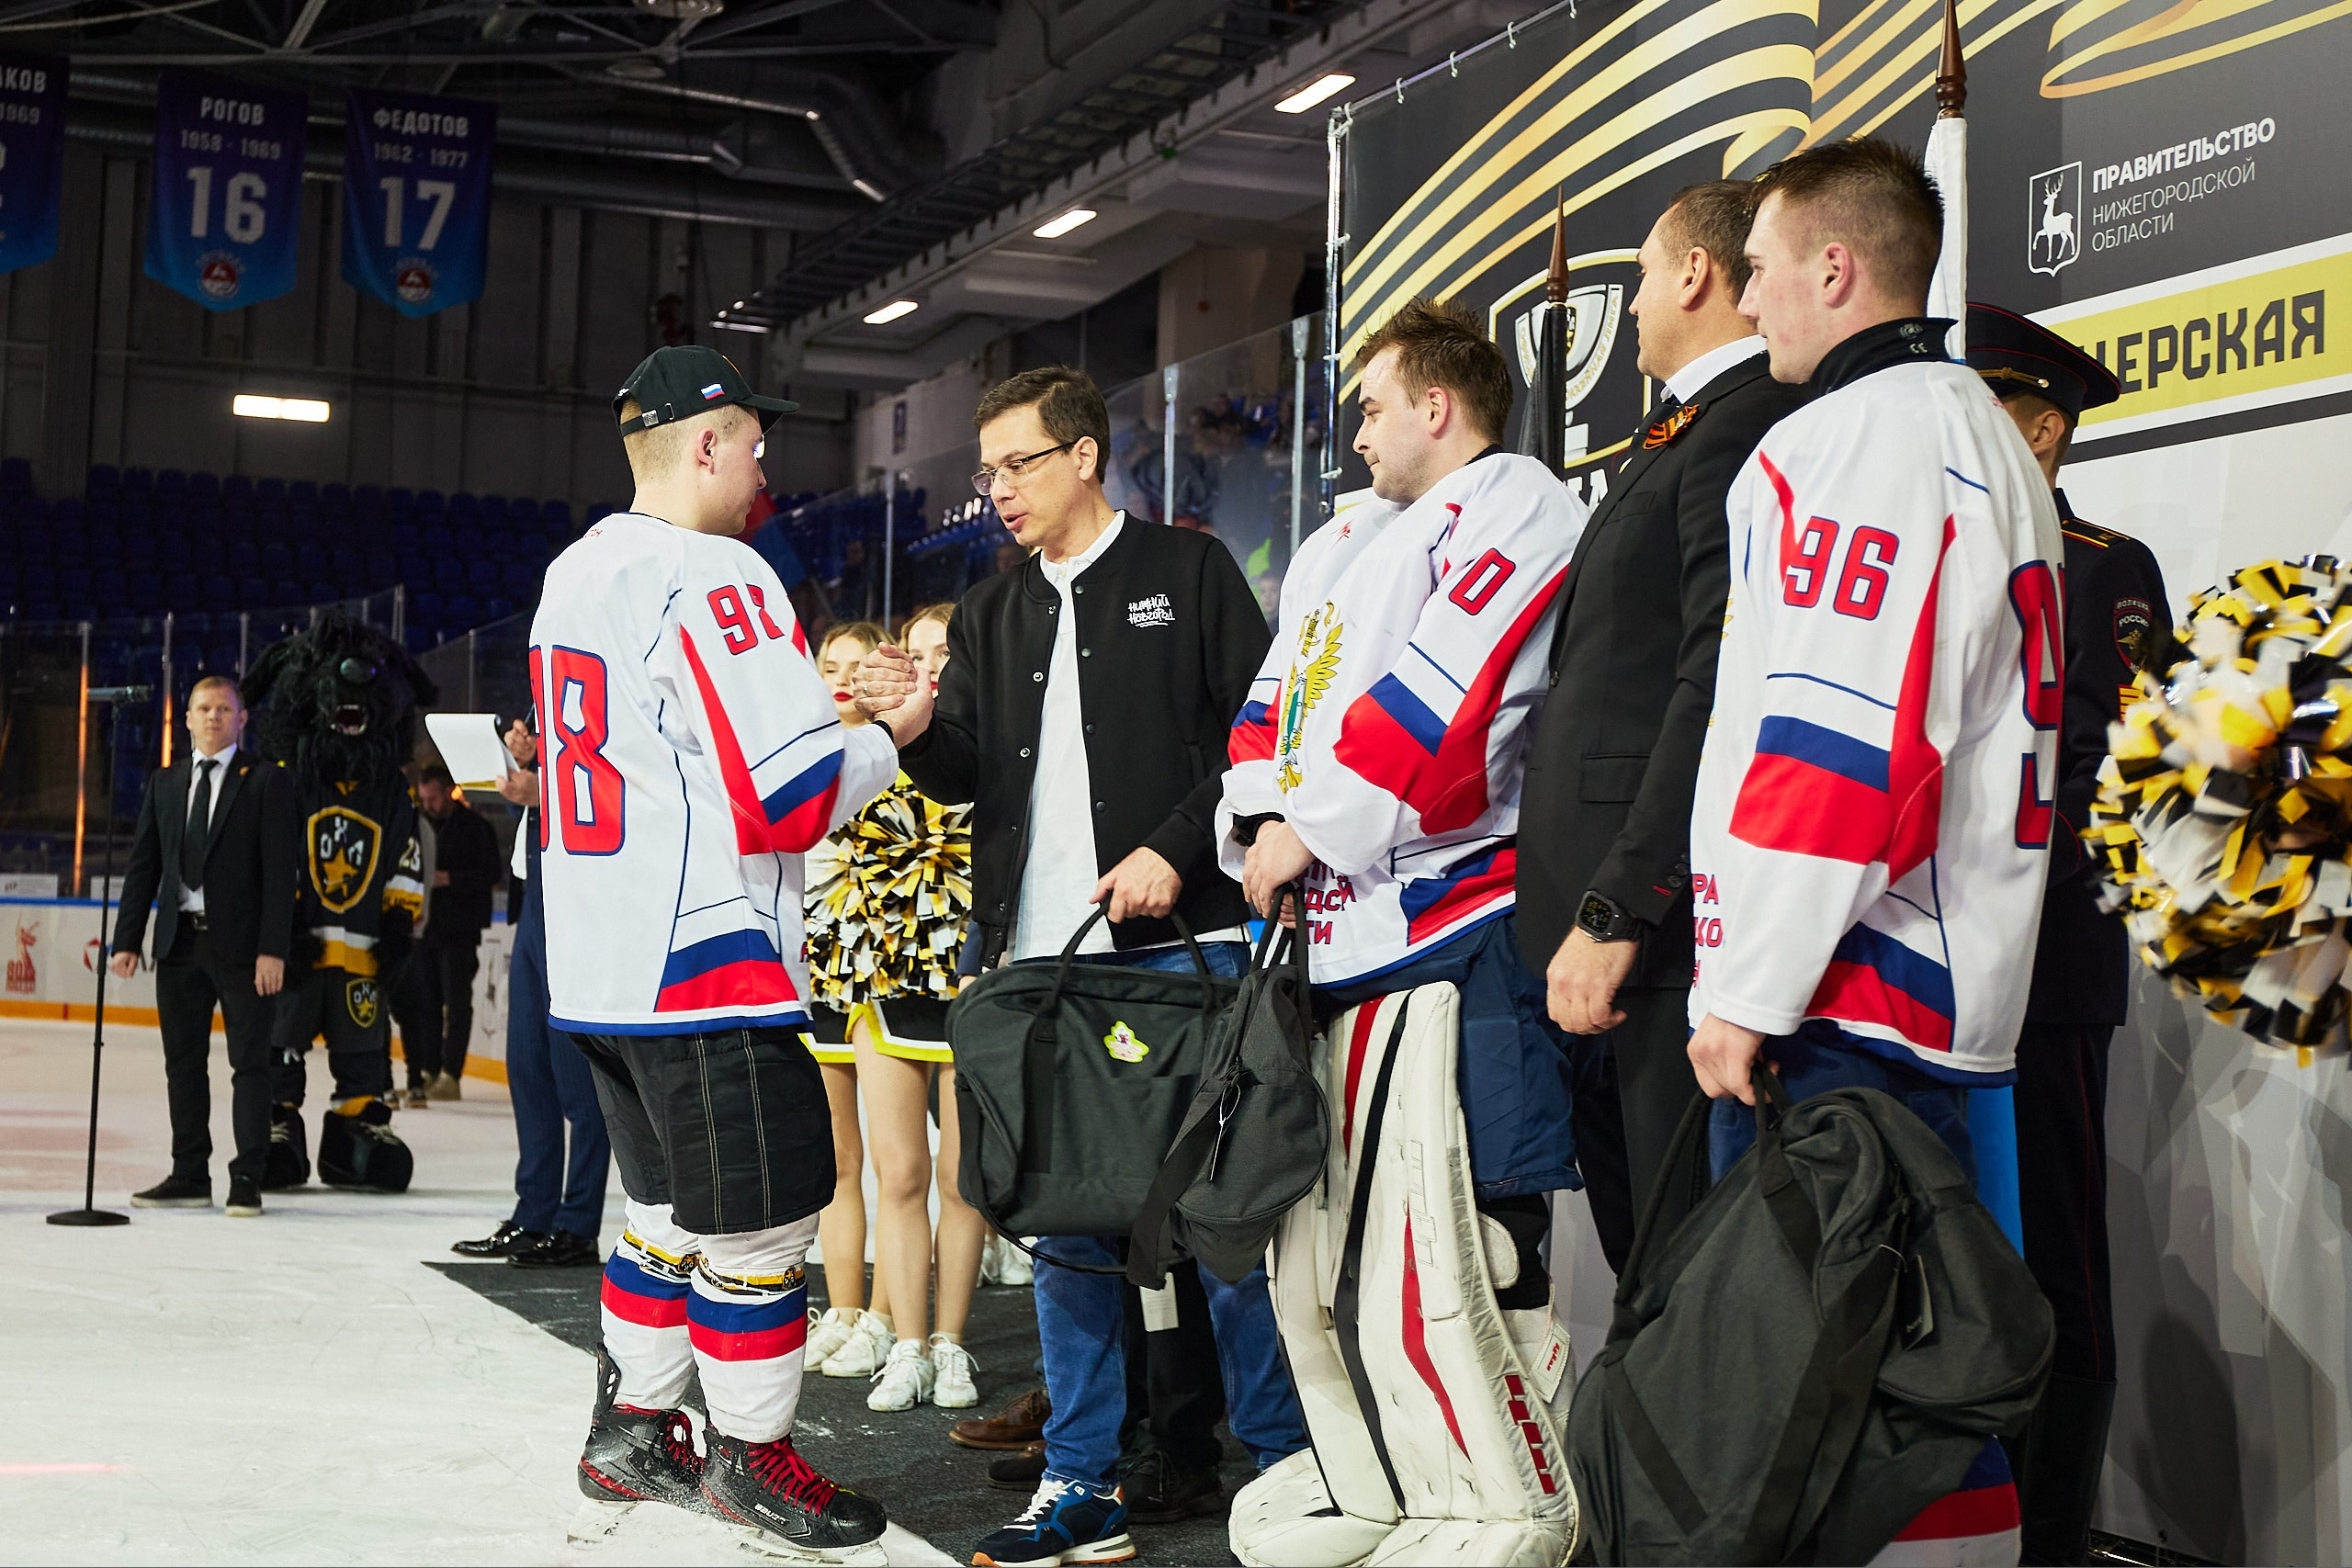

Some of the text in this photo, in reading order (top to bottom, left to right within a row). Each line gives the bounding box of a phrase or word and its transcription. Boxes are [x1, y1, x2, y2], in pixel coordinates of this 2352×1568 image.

[200, 96, 265, 127] РОГОВ
[372, 107, 470, 138] ФЕДОТОВ
[181, 129, 223, 154] 1958
[374, 141, 413, 164] 1962
[430, 147, 469, 169] 1977
[2093, 118, 2275, 193] ПРАВИТЕЛЬСТВО
[187, 165, 268, 245] 16
[379, 176, 457, 251] 17
[2093, 157, 2256, 226] НИЖЕГОРОДСКОЙ
[2092, 212, 2174, 252] ОБЛАСТИ
[1783, 516, 1900, 621] 96
